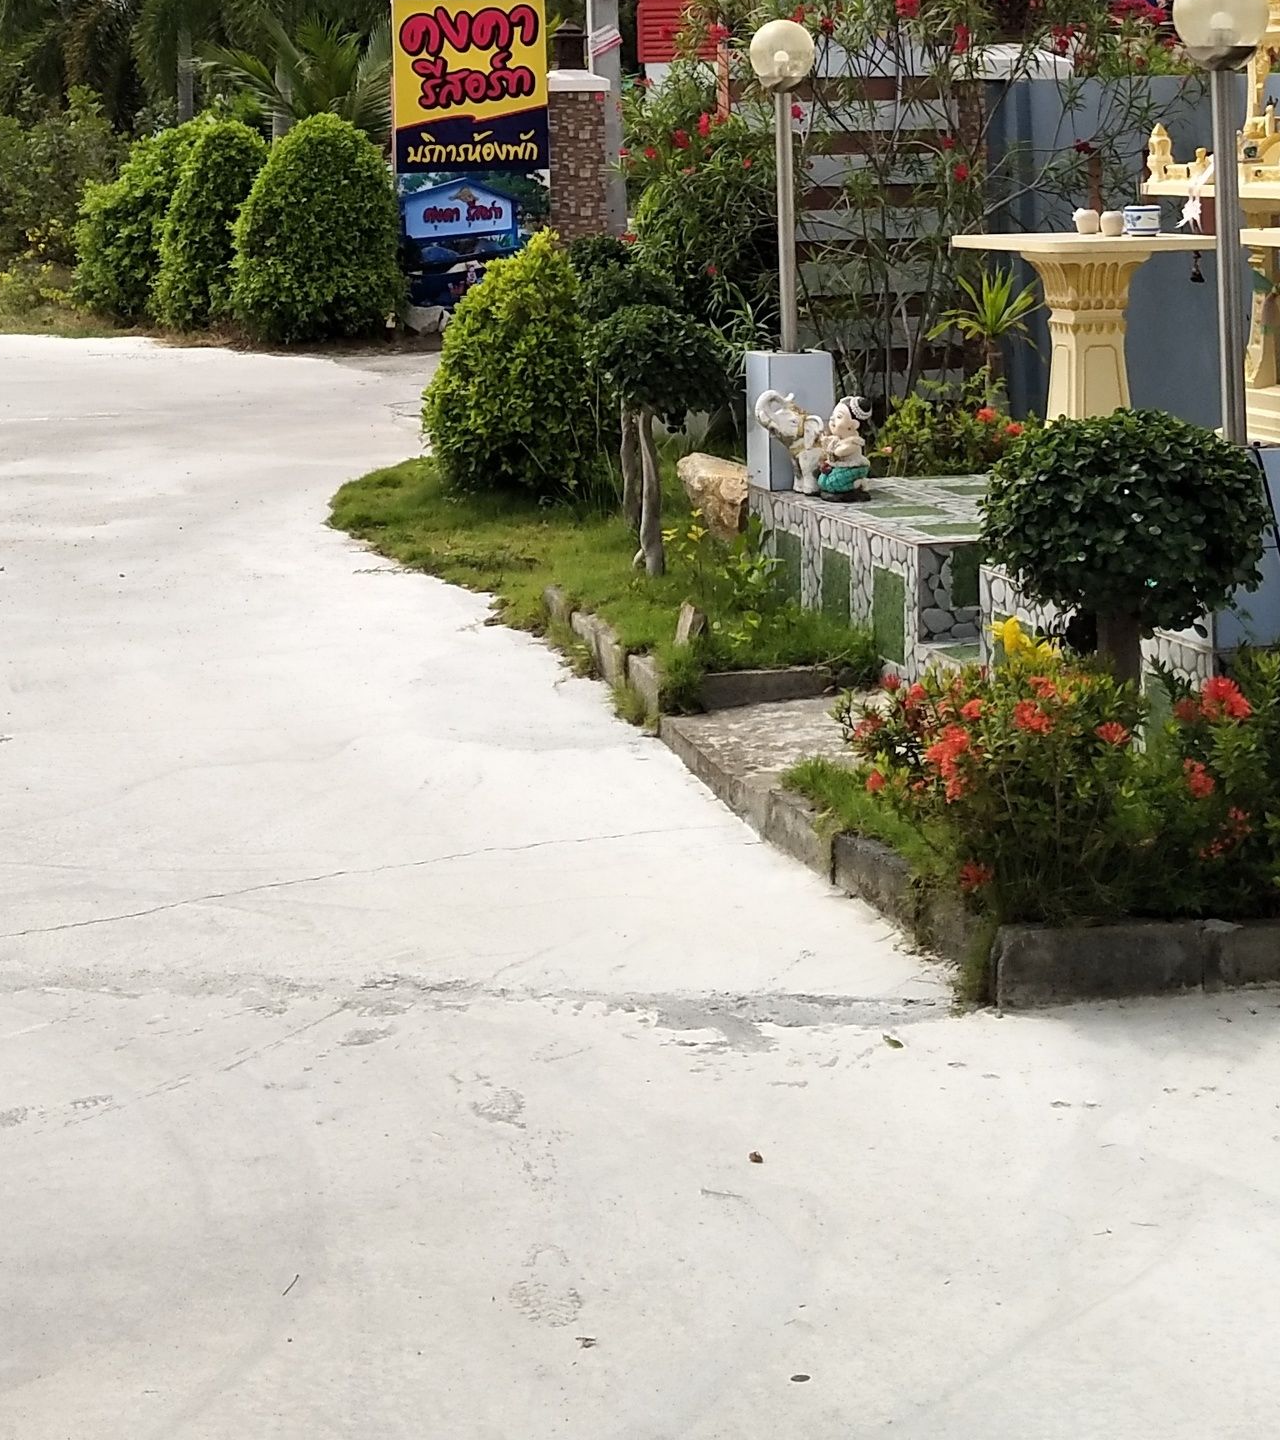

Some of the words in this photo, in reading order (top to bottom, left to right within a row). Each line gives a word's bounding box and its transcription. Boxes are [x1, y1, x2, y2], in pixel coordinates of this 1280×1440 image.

[411, 50, 535, 110] รีสอร์ท
[407, 129, 538, 163] บริการห้องพัก
